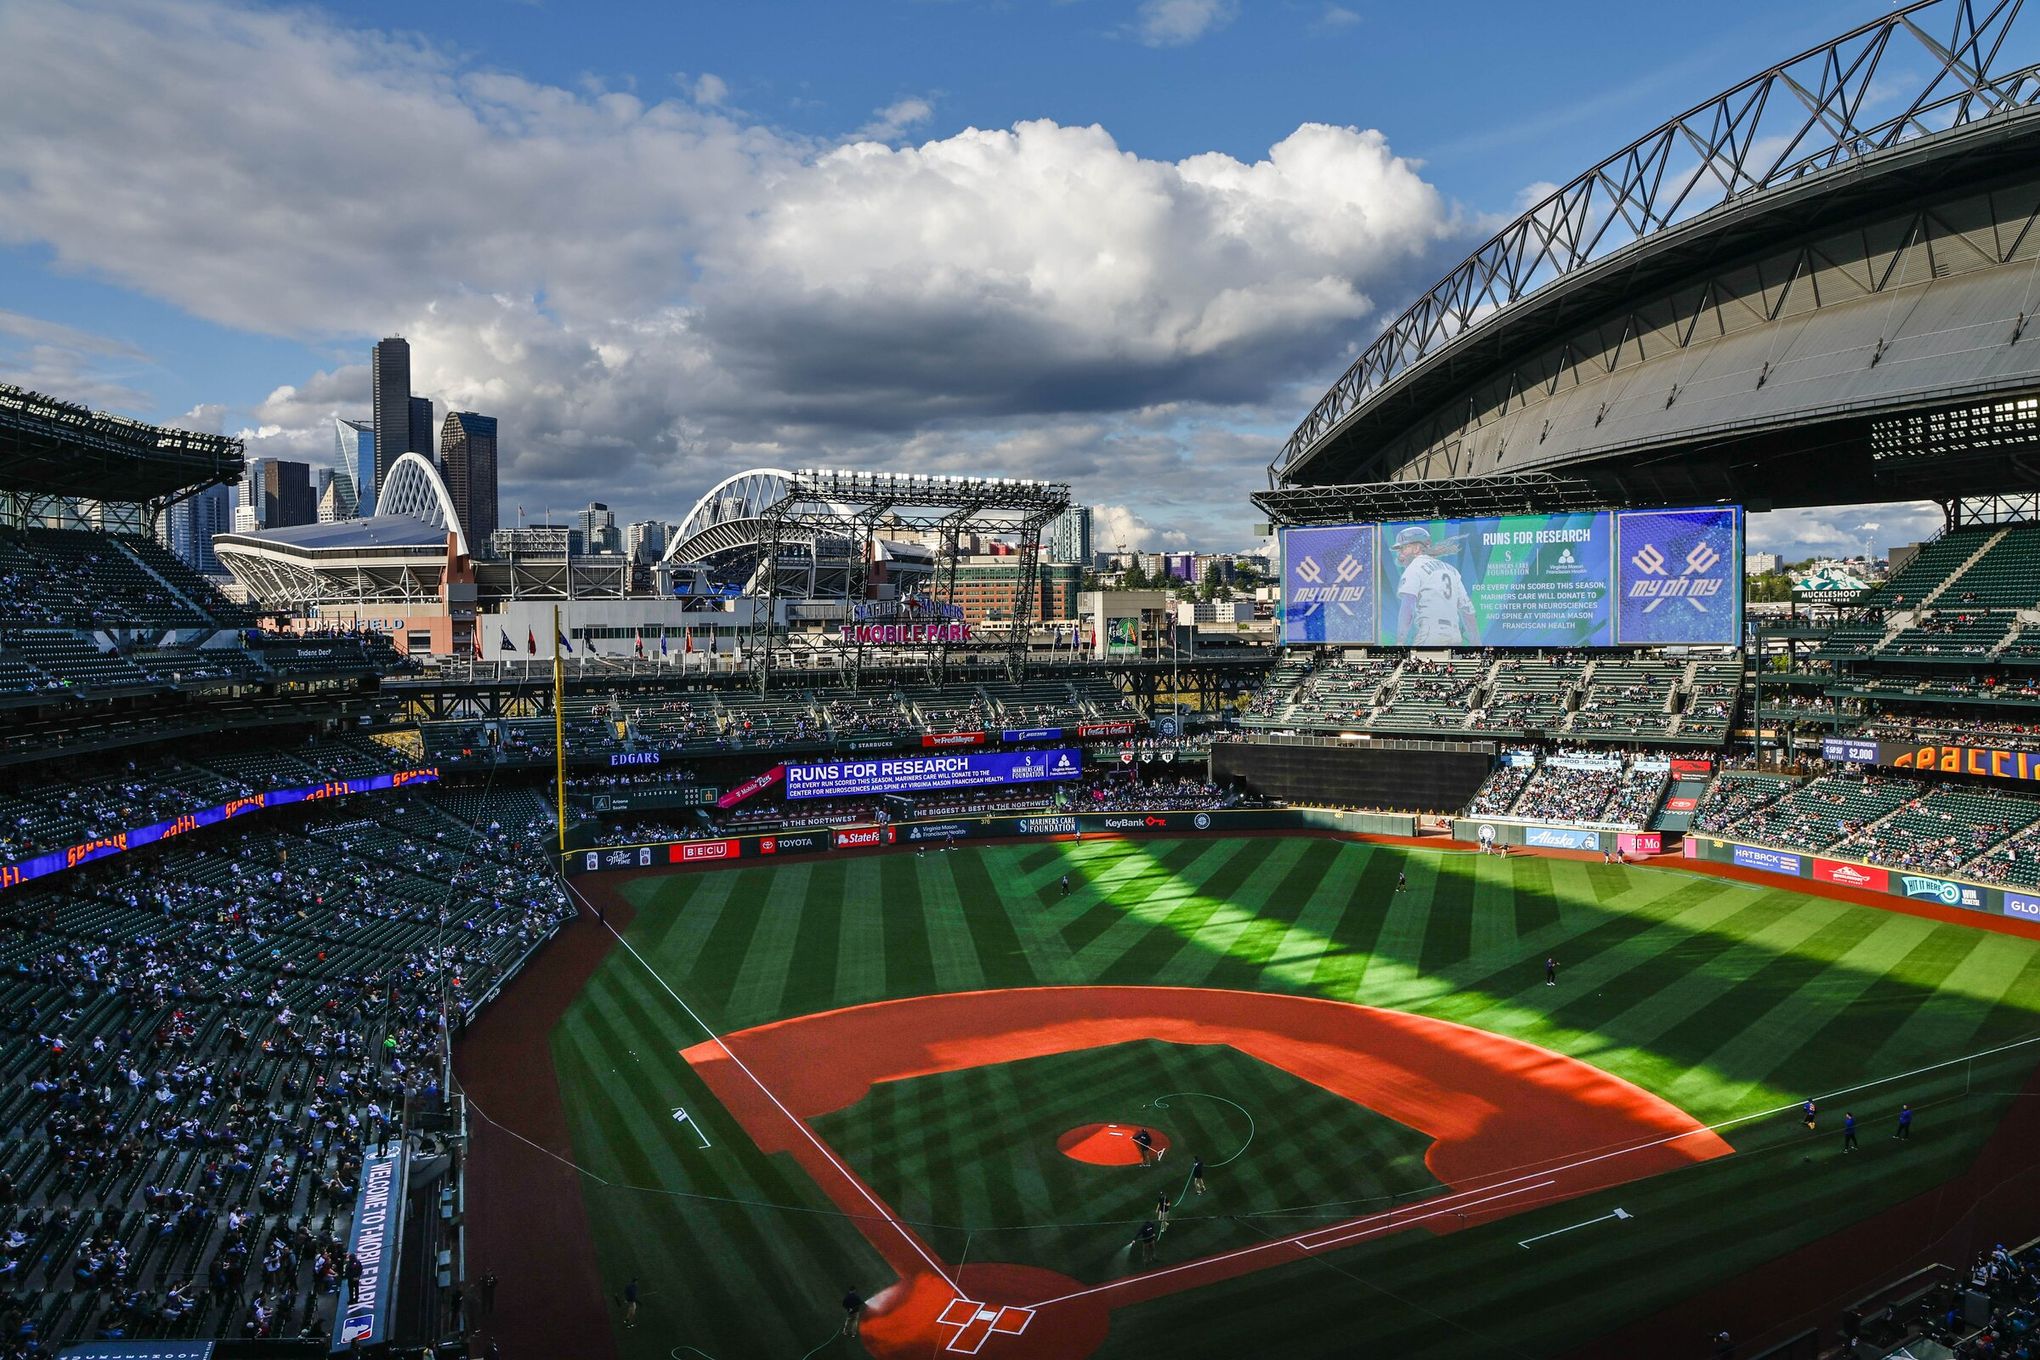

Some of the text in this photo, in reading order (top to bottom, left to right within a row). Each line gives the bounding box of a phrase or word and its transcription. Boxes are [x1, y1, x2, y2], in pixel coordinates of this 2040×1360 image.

[1483, 529, 1590, 545] RUNS FOR RESEARCH
[1442, 573, 1452, 600] 3
[356, 619, 404, 629] FIELD
[840, 623, 972, 643] T-MOBILE PARK
[611, 753, 660, 765] EDGARS
[1849, 748, 1872, 760] $2,000
[791, 758, 968, 781] RUNS FOR RESEARCH
[825, 786, 870, 794] NEUROSCIENCES
[929, 807, 959, 815] BIGGEST
[808, 816, 857, 825] NORTHWEST
[1030, 818, 1059, 826] MARINERS
[1106, 819, 1144, 828] KeyBank
[1030, 823, 1076, 832] FOUNDATION
[778, 839, 812, 848] TOYOTA
[1529, 831, 1575, 847] Alaska
[1735, 849, 1779, 863] HATBACK
[1908, 880, 1918, 892] HIT
[1920, 880, 1924, 890] IT
[2011, 901, 2040, 914] GLO
[364, 1161, 392, 1210] WELCOME
[361, 1208, 386, 1225] TO
[347, 1276, 378, 1314] PARK
